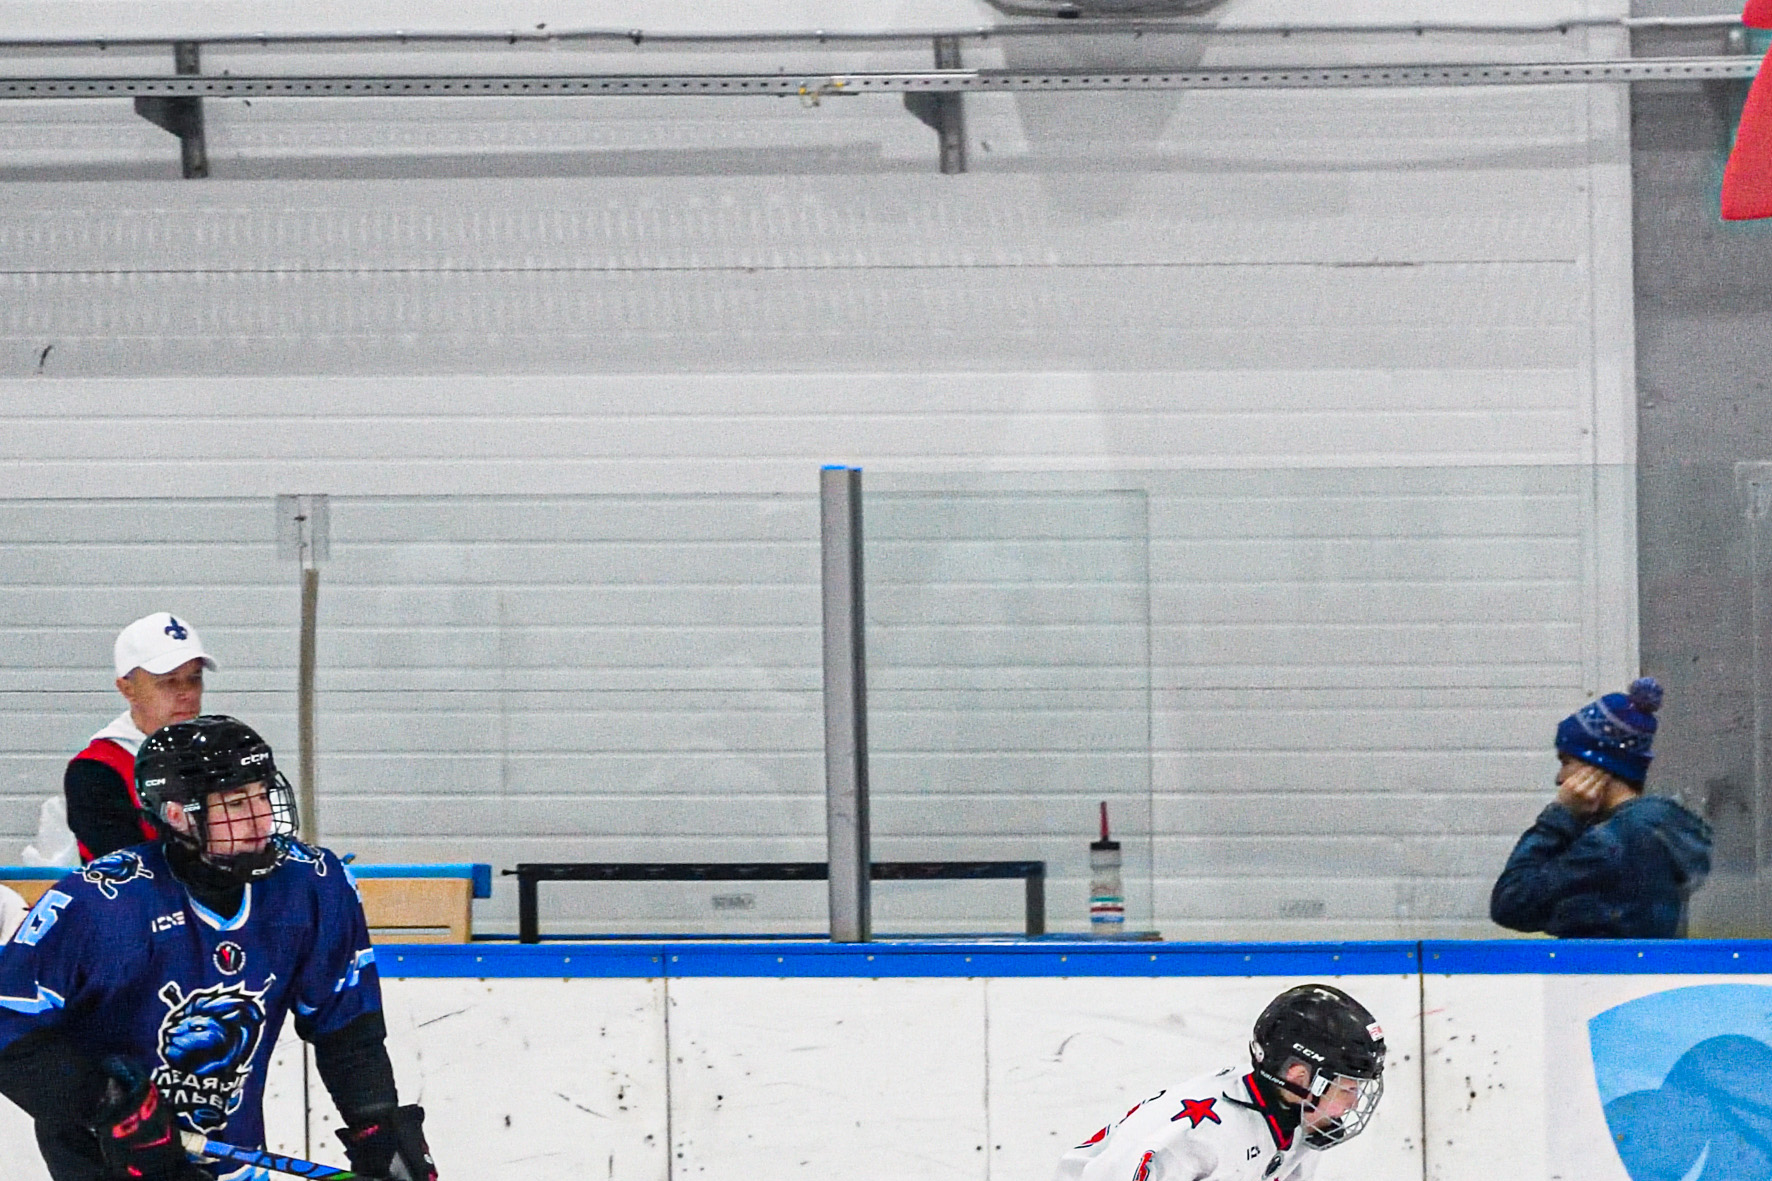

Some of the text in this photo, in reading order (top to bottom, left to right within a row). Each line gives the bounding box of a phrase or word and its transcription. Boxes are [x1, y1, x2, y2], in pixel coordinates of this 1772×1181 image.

[241, 752, 270, 766] CCM
[145, 778, 167, 787] CCM
[1293, 1042, 1325, 1061] CCM
